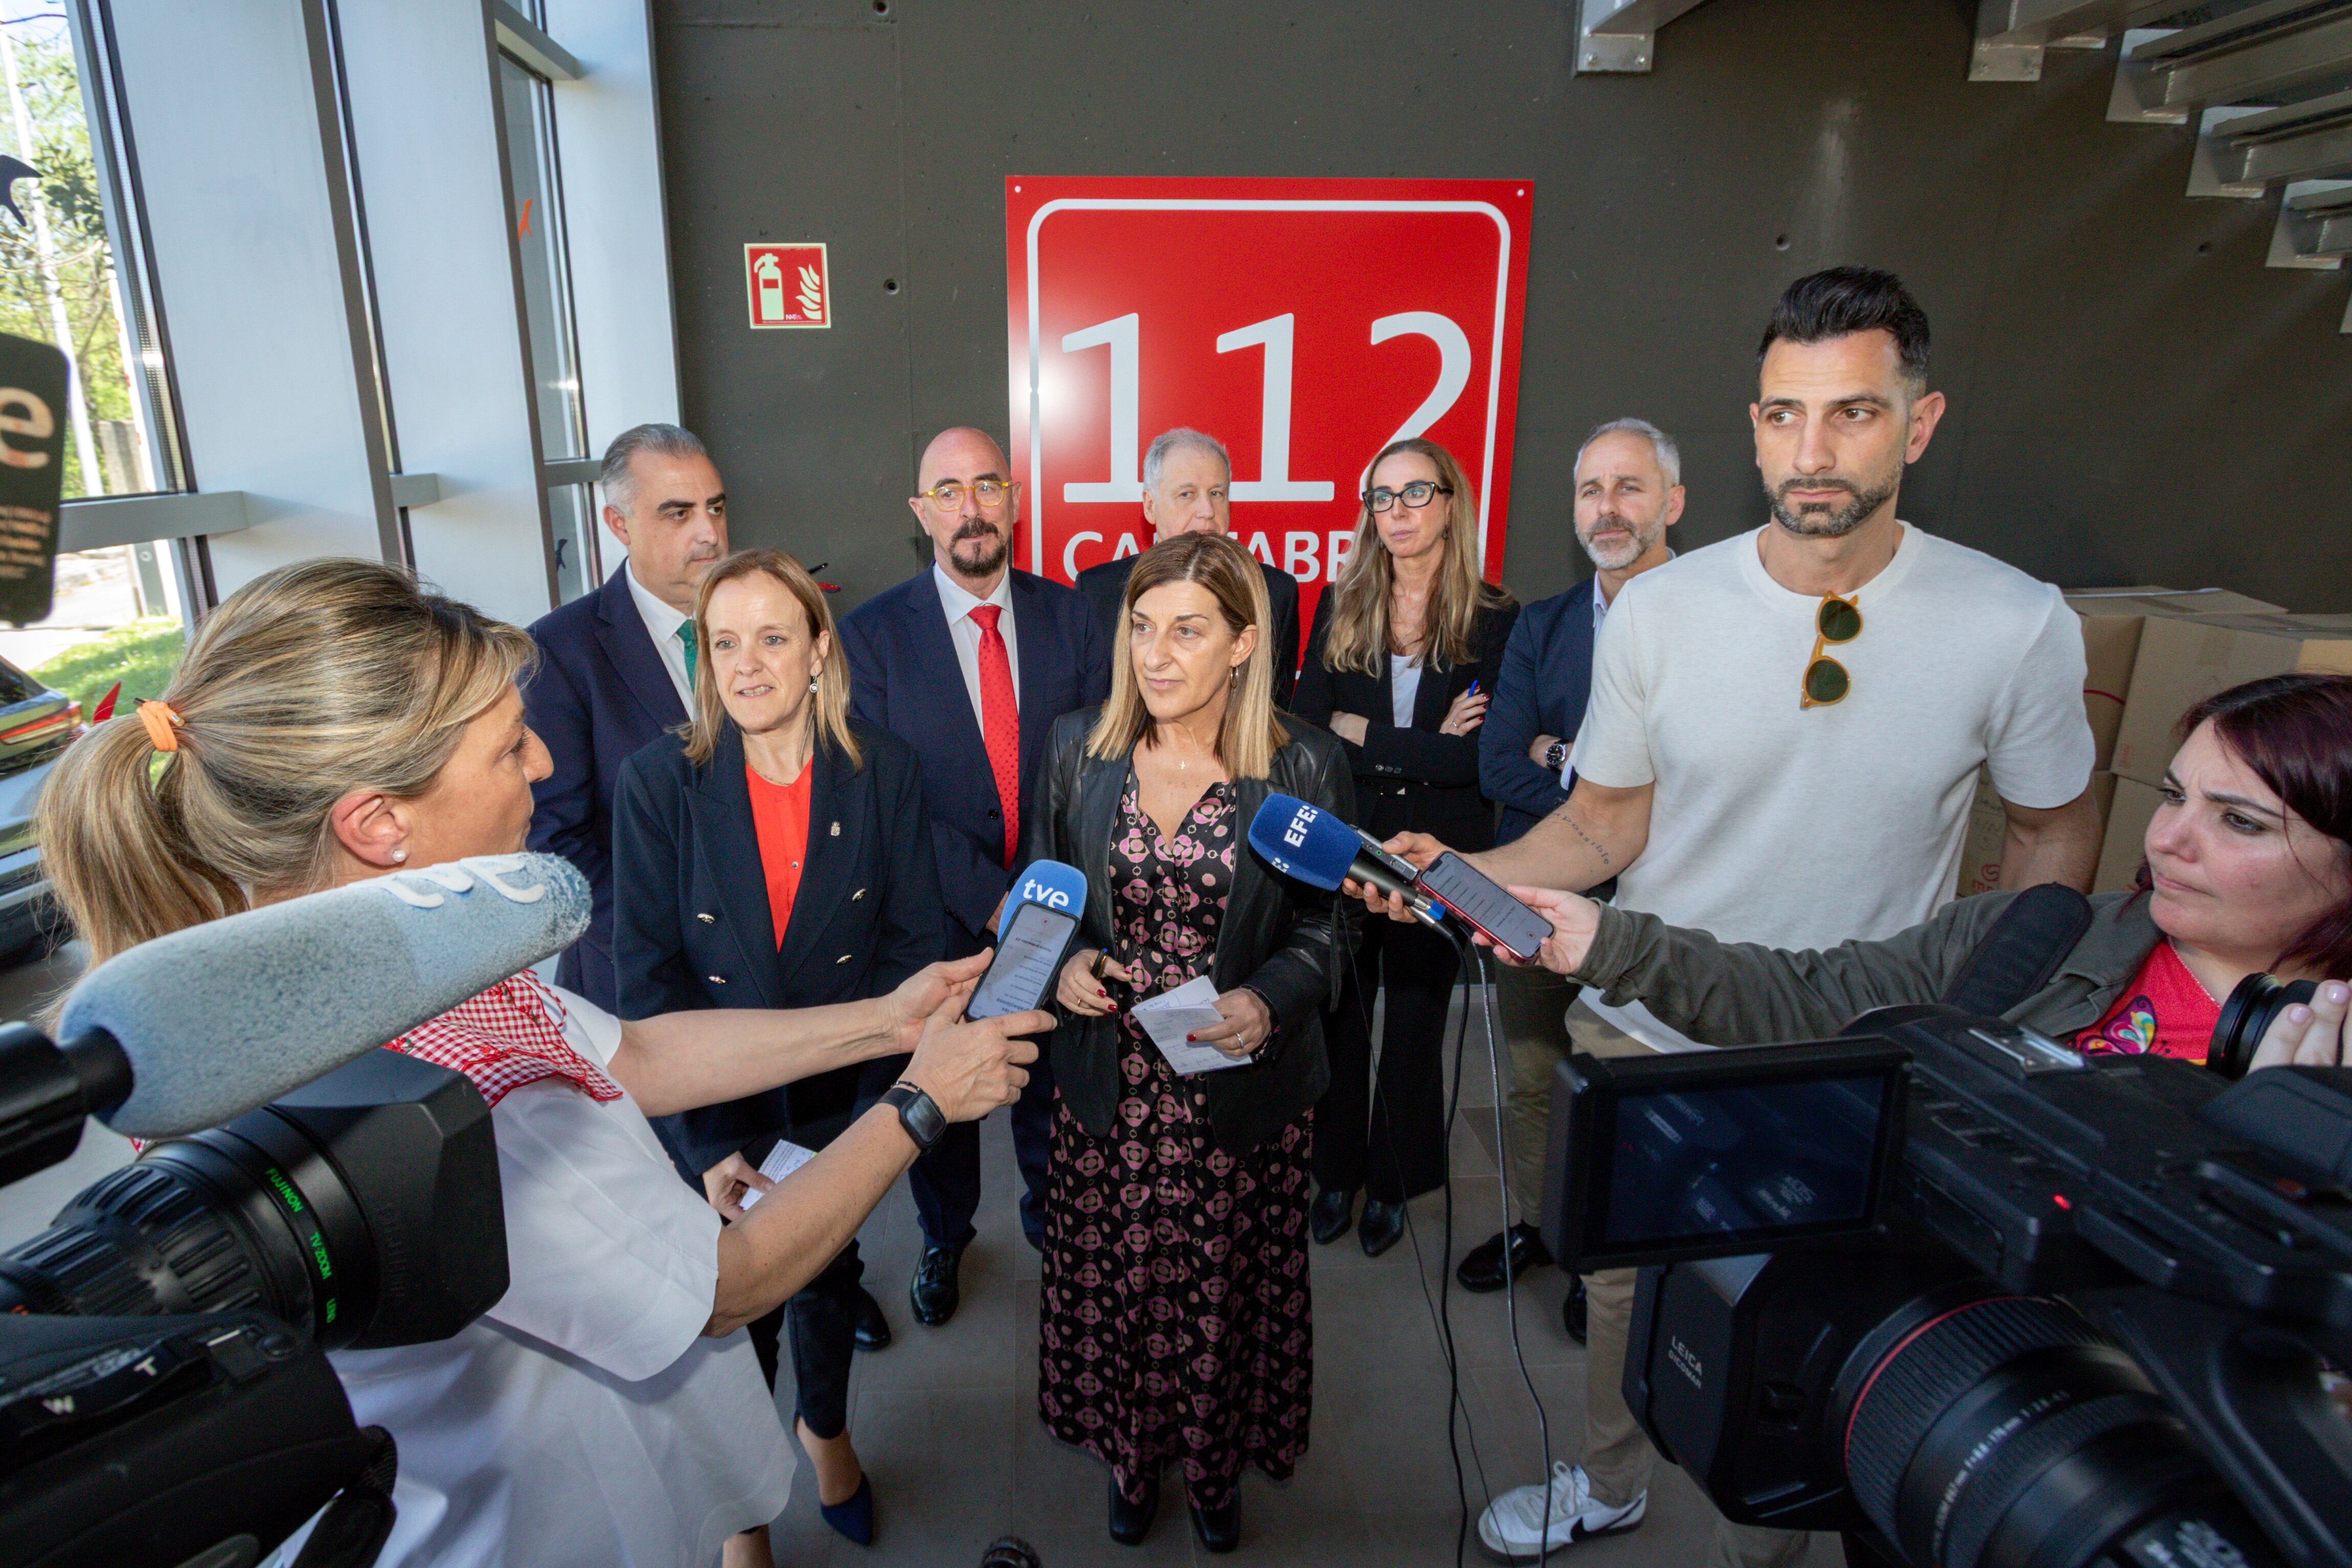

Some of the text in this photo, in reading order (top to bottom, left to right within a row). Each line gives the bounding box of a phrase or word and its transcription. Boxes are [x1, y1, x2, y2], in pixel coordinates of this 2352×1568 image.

[1062, 311, 1471, 503] 112
[1023, 879, 1069, 909] tve
[265, 1167, 304, 1213] FUJINON
[1671, 1335, 1703, 1376] LEICA
